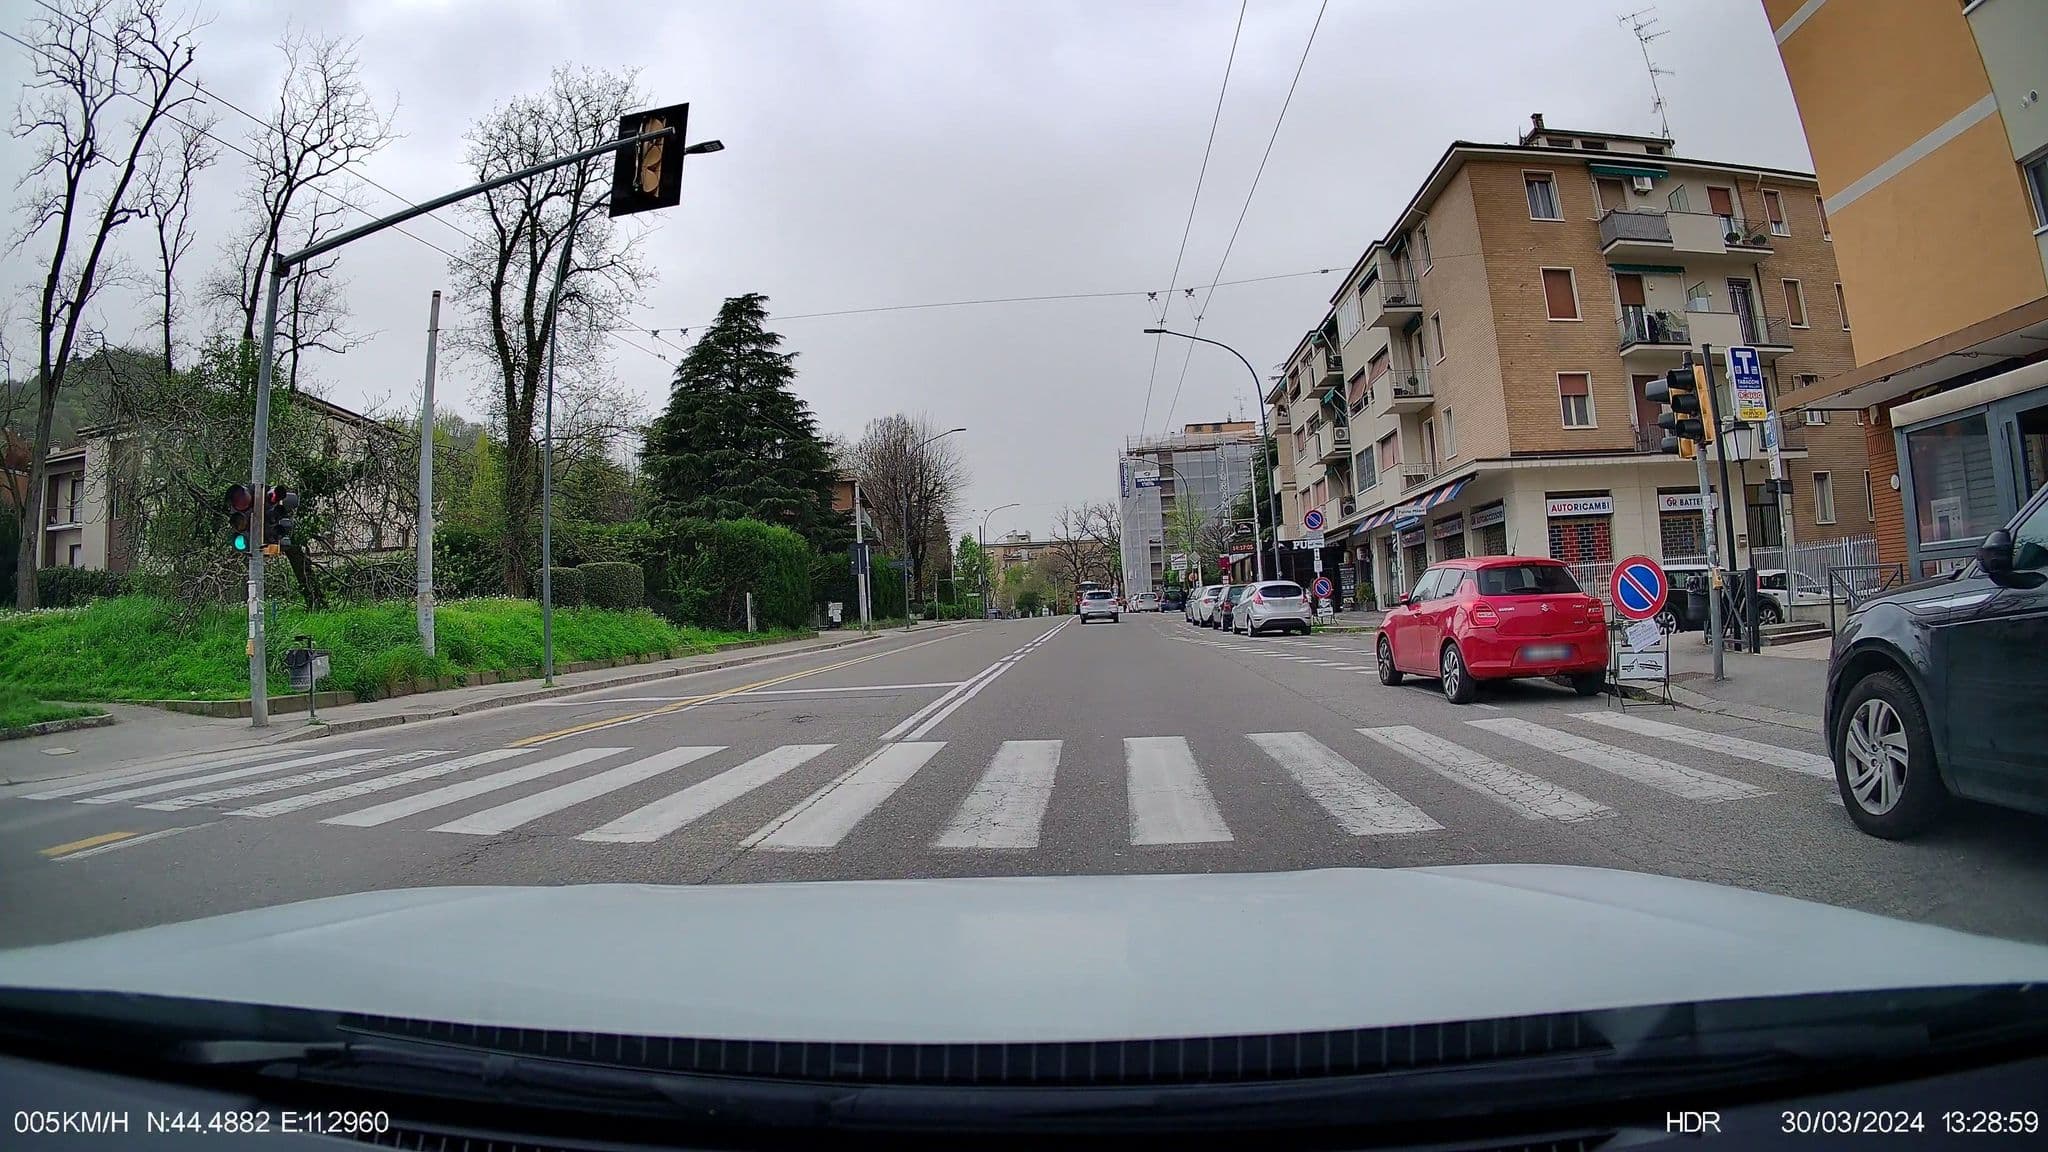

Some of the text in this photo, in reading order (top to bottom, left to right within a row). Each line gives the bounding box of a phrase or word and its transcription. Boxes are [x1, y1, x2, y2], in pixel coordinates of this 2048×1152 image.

[1735, 351, 1752, 374] T
[1551, 501, 1610, 513] AUTORICAMBI
[1680, 498, 1702, 506] BATTE
